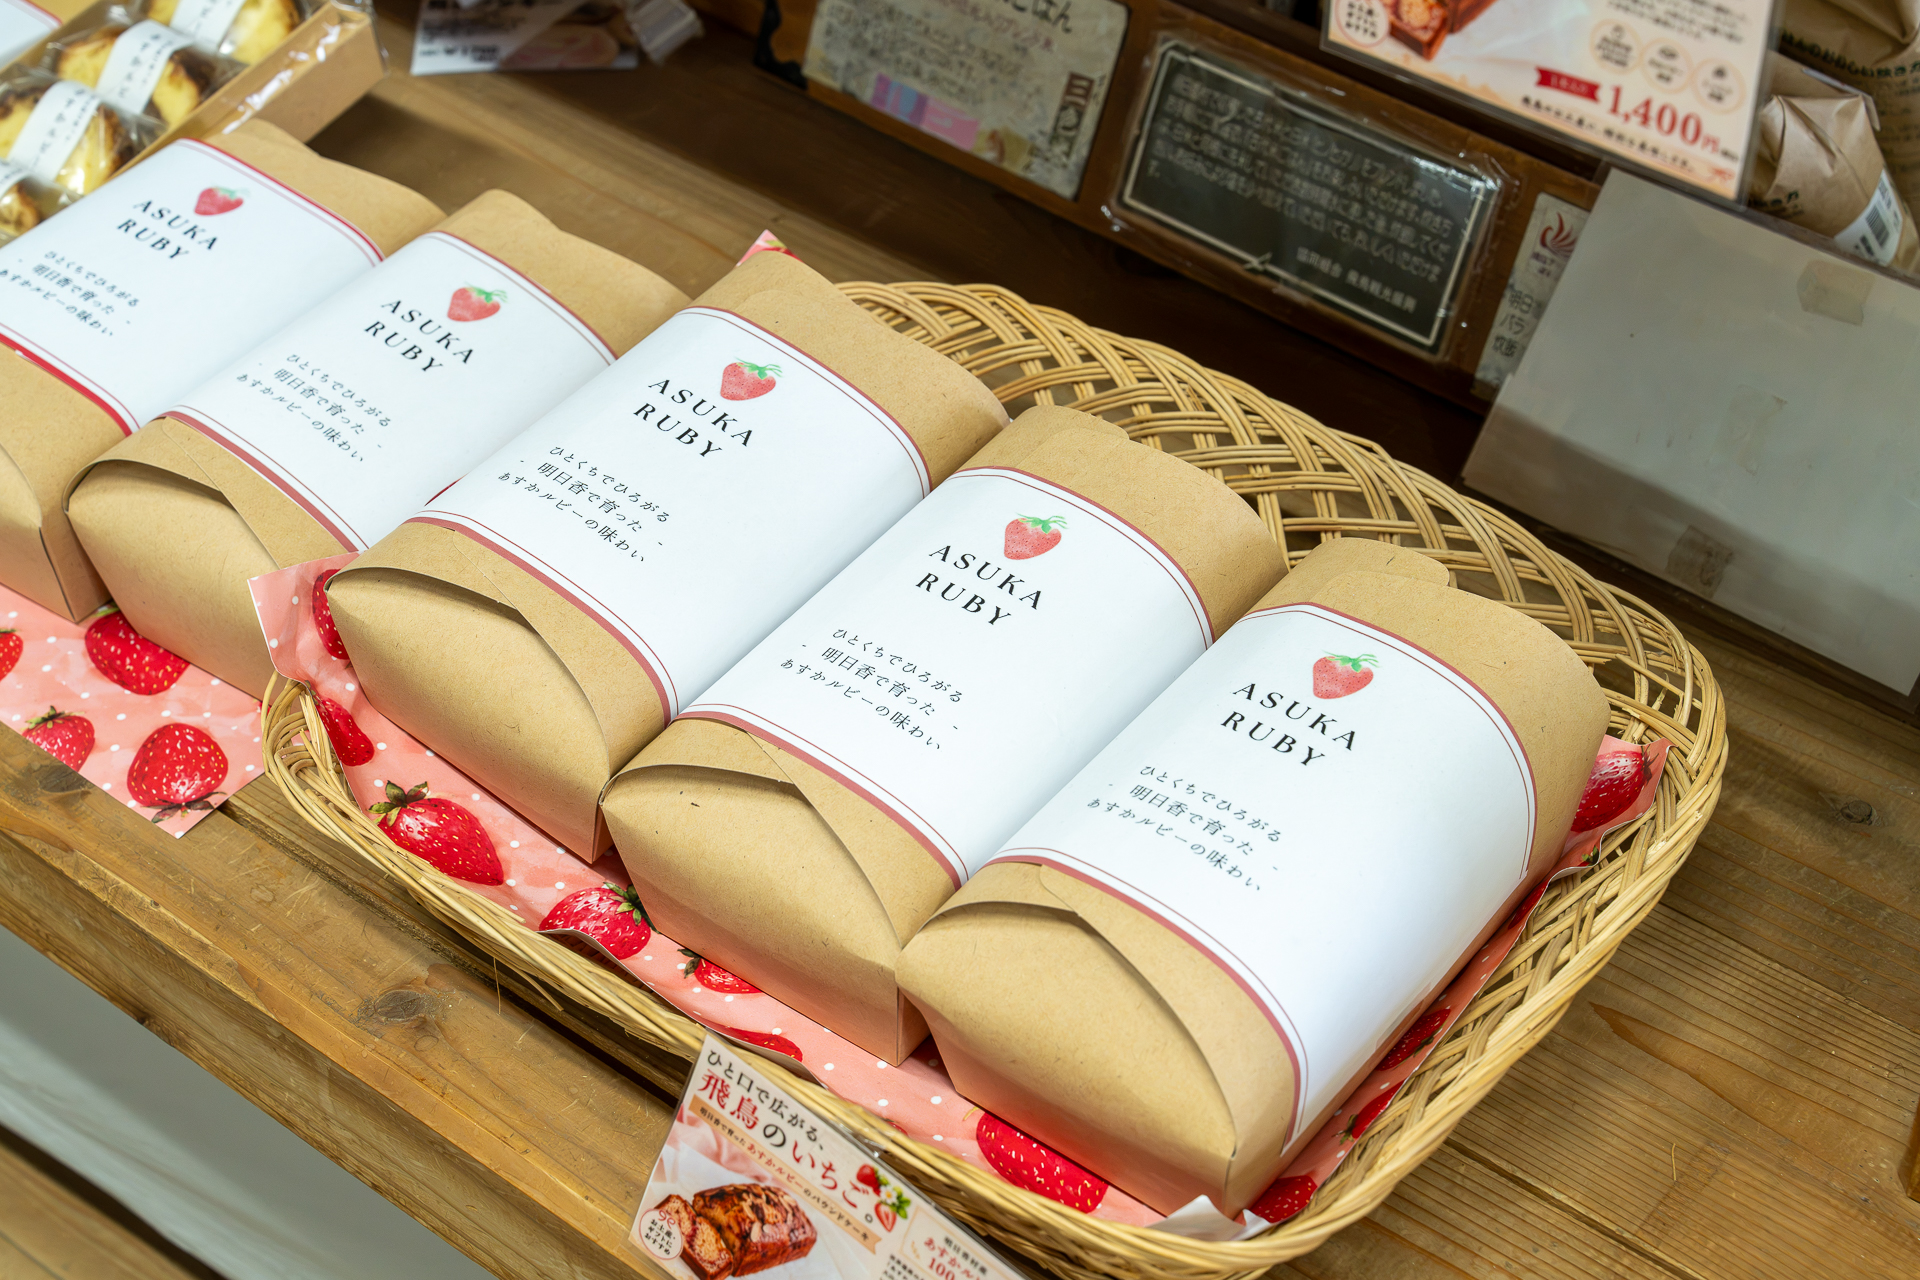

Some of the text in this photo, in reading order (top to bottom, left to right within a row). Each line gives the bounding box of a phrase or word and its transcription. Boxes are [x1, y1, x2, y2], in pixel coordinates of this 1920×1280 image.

[117, 219, 190, 259] RUBY
[133, 200, 218, 250] ASUKA
[32, 264, 115, 315] 明日香で育った
[45, 251, 140, 307] ひとくちでひろがる
[364, 320, 444, 372] RUBY
[381, 300, 474, 364] ASUKA
[236, 374, 364, 462] あすかルビーの味わい
[274, 368, 365, 435] 明日香で育った
[286, 353, 392, 427] ひとくちでひろがる
[648, 379, 755, 447] ASUKA
[633, 402, 723, 458] RUBY
[498, 471, 645, 562] あすかルビーの味わい
[537, 462, 643, 532] 明日香で育った
[549, 446, 671, 523] ひとくちでひろがる
[915, 572, 1011, 626] RUBY
[929, 545, 1043, 610] ASUKA
[821, 647, 936, 716] 明日香で育った
[832, 628, 962, 703] ひとくちでひろがる
[780, 659, 941, 750] あすかルビーの味わい
[1221, 710, 1326, 767] RUBY
[1233, 682, 1357, 751] ASUKA
[1130, 784, 1254, 856] 明日香で育った
[1140, 765, 1282, 843] ひとくちでひろがる
[1087, 798, 1261, 891] あすかルビーの味わい
[706, 1050, 824, 1152] ひと口で広がる、
[698, 1070, 874, 1224] 飛鳥のいちご。
[645, 1233, 670, 1255] おすすめ
[648, 1226, 673, 1248] ギフトに
